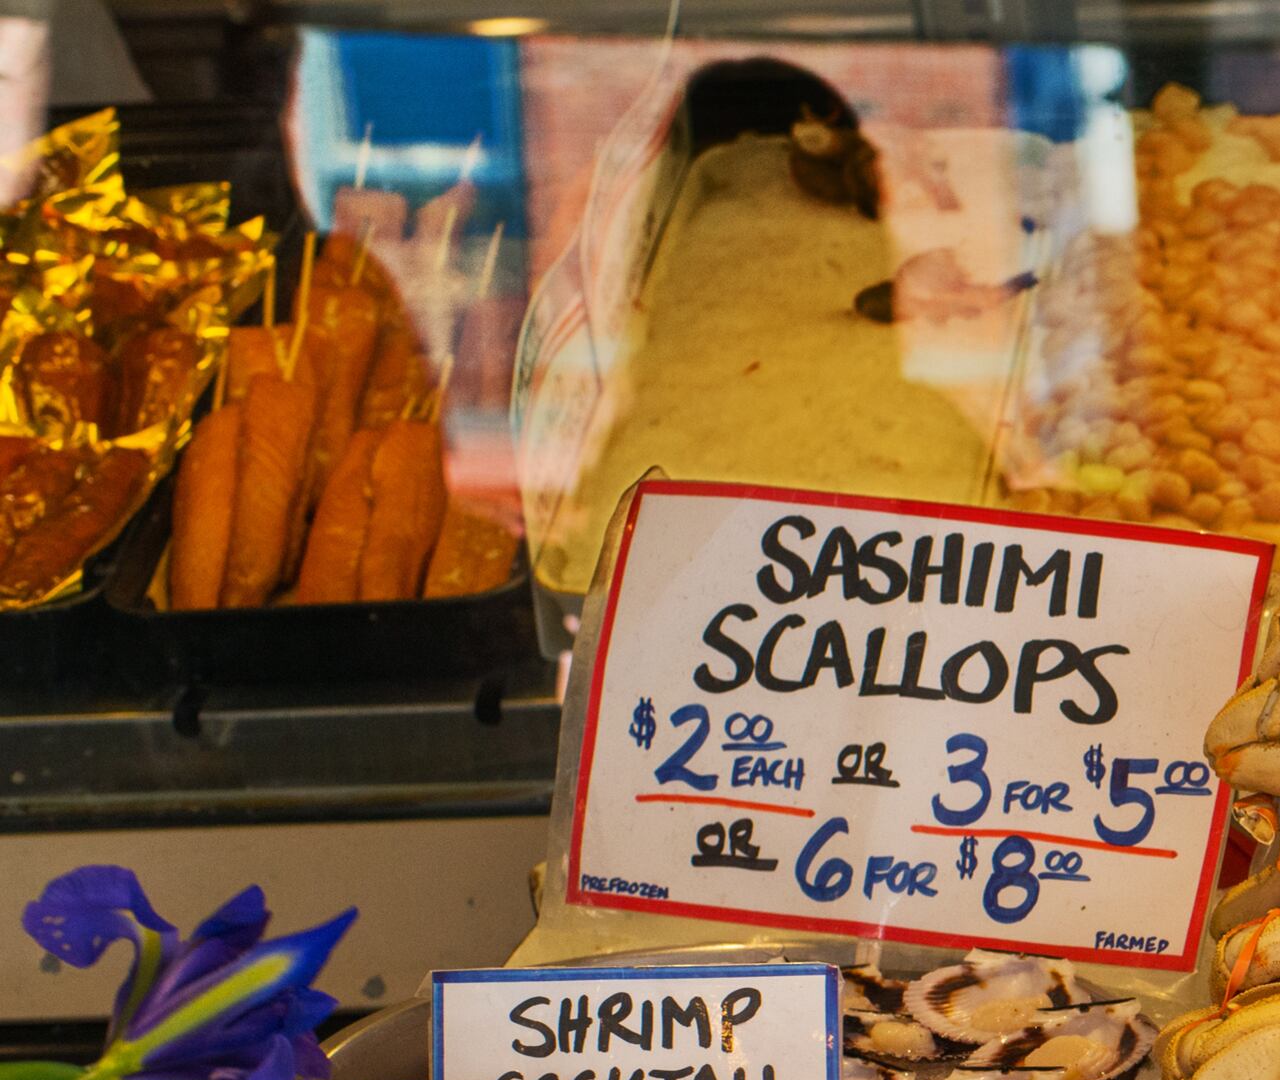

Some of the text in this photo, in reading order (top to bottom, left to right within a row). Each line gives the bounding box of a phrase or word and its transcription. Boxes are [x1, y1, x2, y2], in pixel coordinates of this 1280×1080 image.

[756, 515, 1103, 619] SASHIMI
[692, 603, 1131, 725] SCALLOPS
[730, 755, 804, 791] EACH
[836, 742, 893, 780] OR
[931, 732, 992, 826] 3
[1002, 781, 1071, 814] FOR
[580, 872, 669, 900] PREFROZEN
[695, 818, 761, 859] OR
[794, 817, 853, 902] 6
[863, 856, 938, 898] FOR
[1094, 931, 1169, 955] FARMED
[509, 987, 762, 1058] SHRIMP
